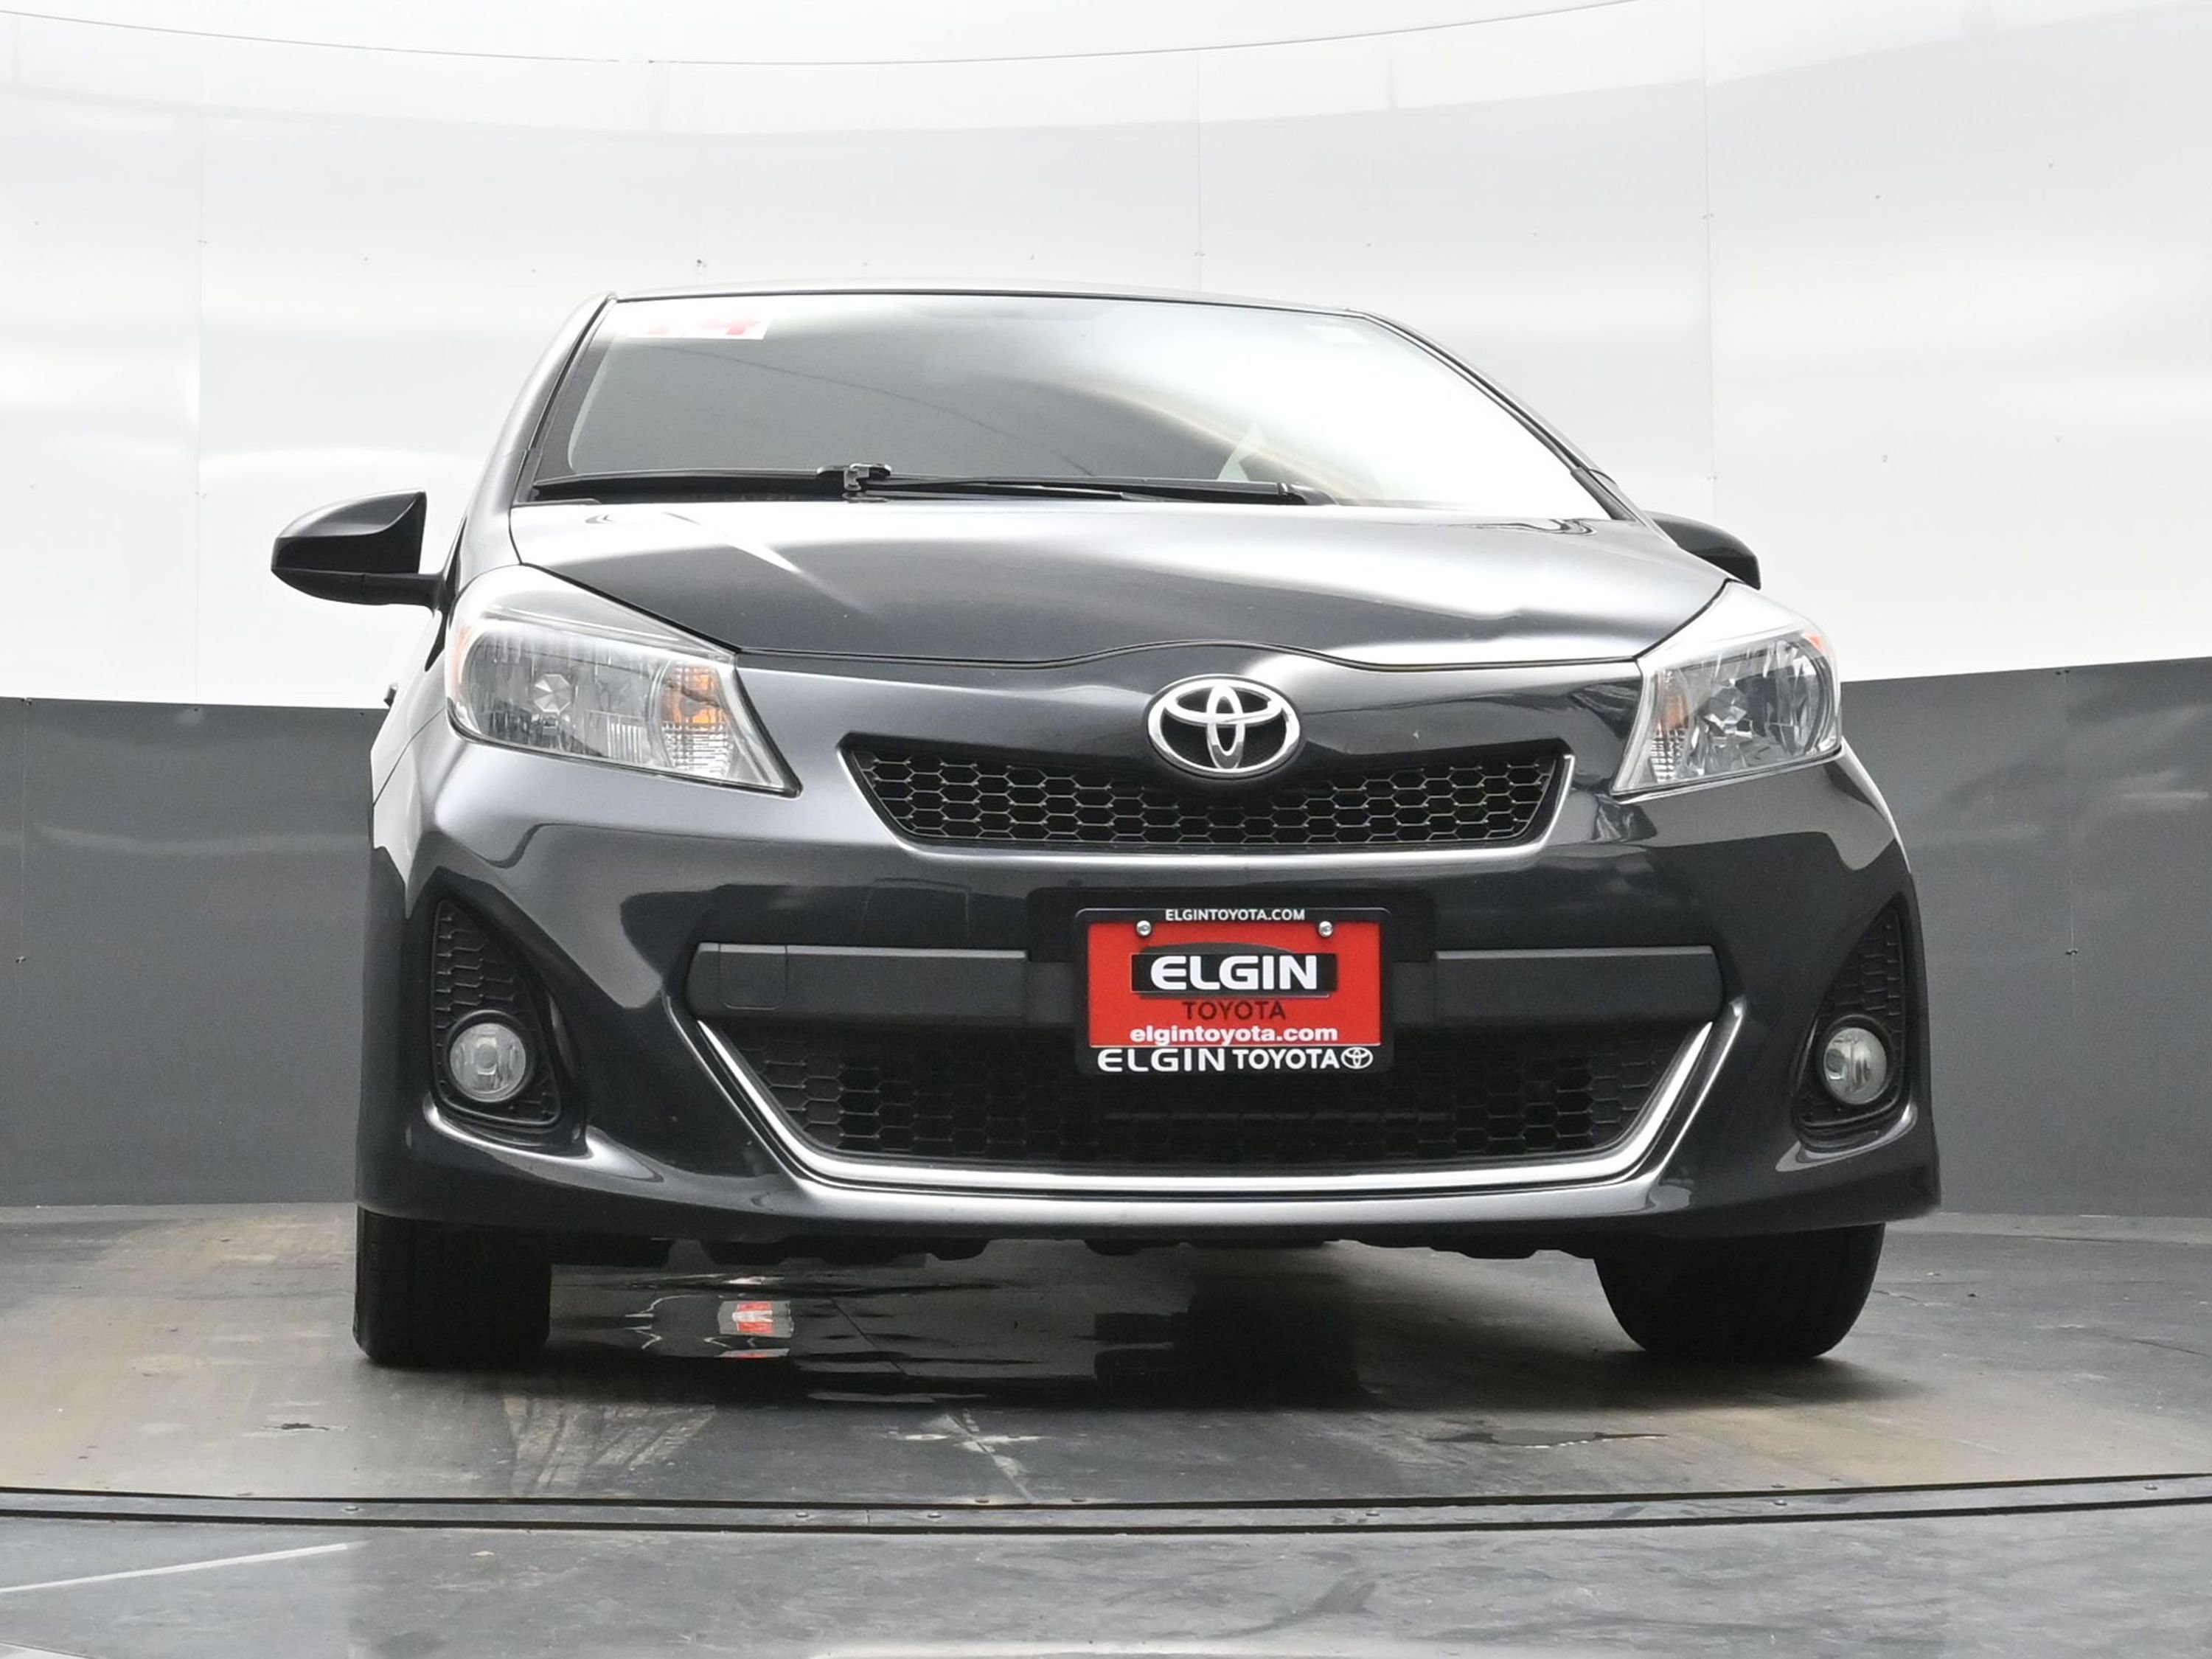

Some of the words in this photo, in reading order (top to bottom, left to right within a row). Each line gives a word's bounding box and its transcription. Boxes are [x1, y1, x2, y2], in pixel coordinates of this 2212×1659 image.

[1165, 908, 1306, 921] ELGINTOYOTA.COM
[1150, 955, 1318, 990] ELGIN
[1183, 1001, 1286, 1020] TOYOTA
[1129, 1026, 1338, 1046] elgintoyota.com
[1097, 1048, 1225, 1072] ELGIN
[1232, 1048, 1340, 1070] TOYOTA
